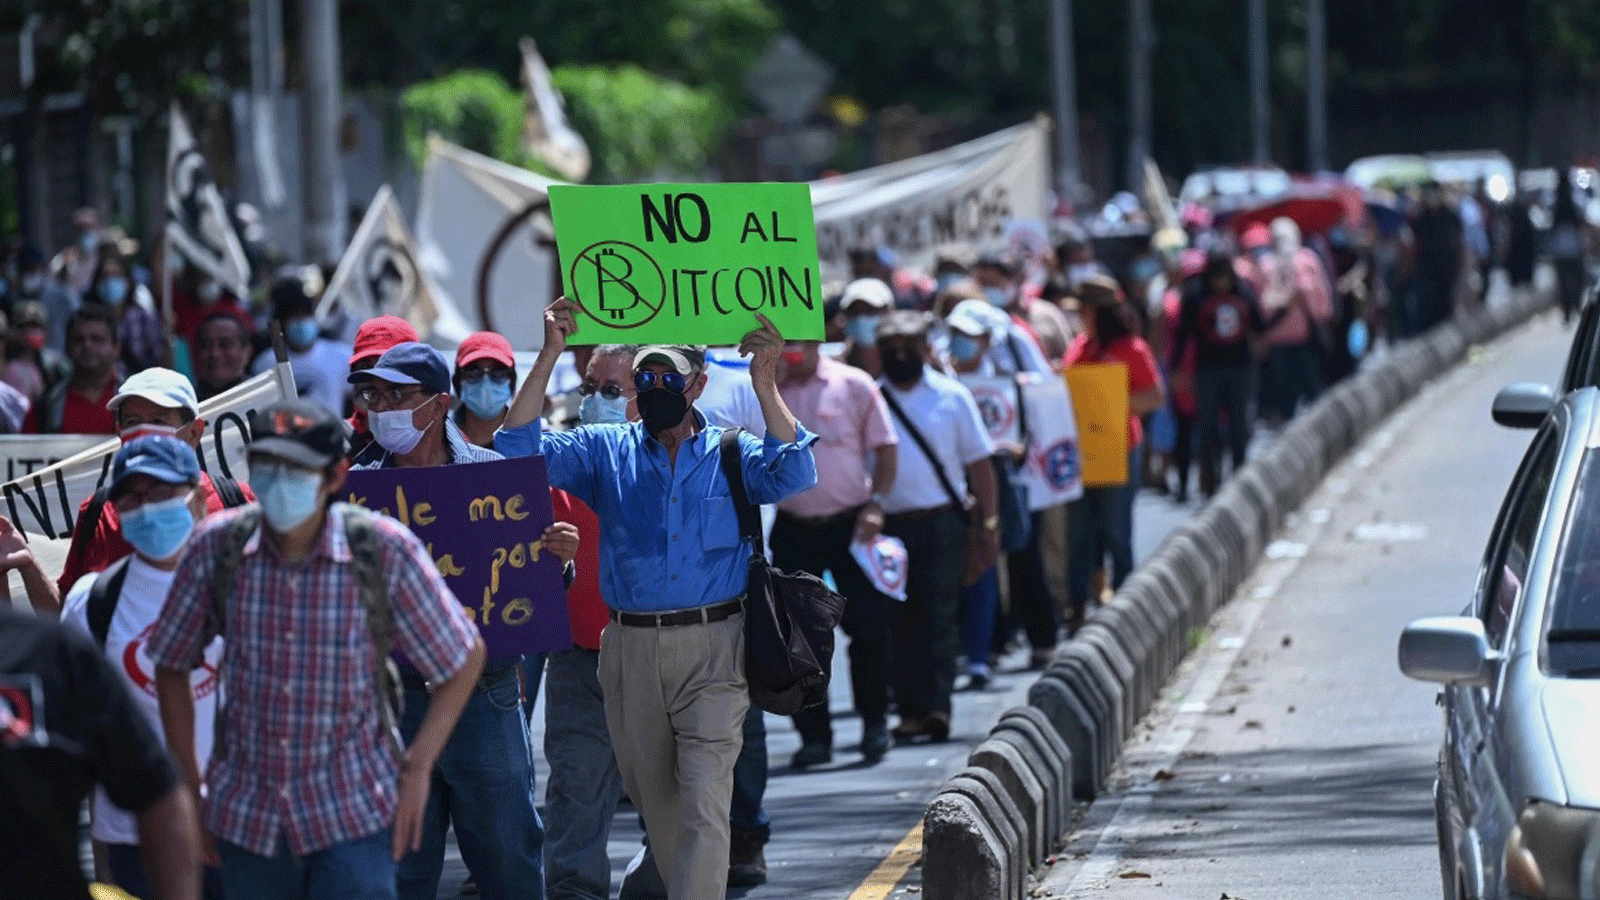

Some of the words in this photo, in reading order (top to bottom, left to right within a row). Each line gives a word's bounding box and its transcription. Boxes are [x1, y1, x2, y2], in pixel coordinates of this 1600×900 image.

[640, 193, 711, 243] NO
[740, 210, 797, 243] AL
[468, 494, 530, 523] me
[491, 543, 544, 595] por
